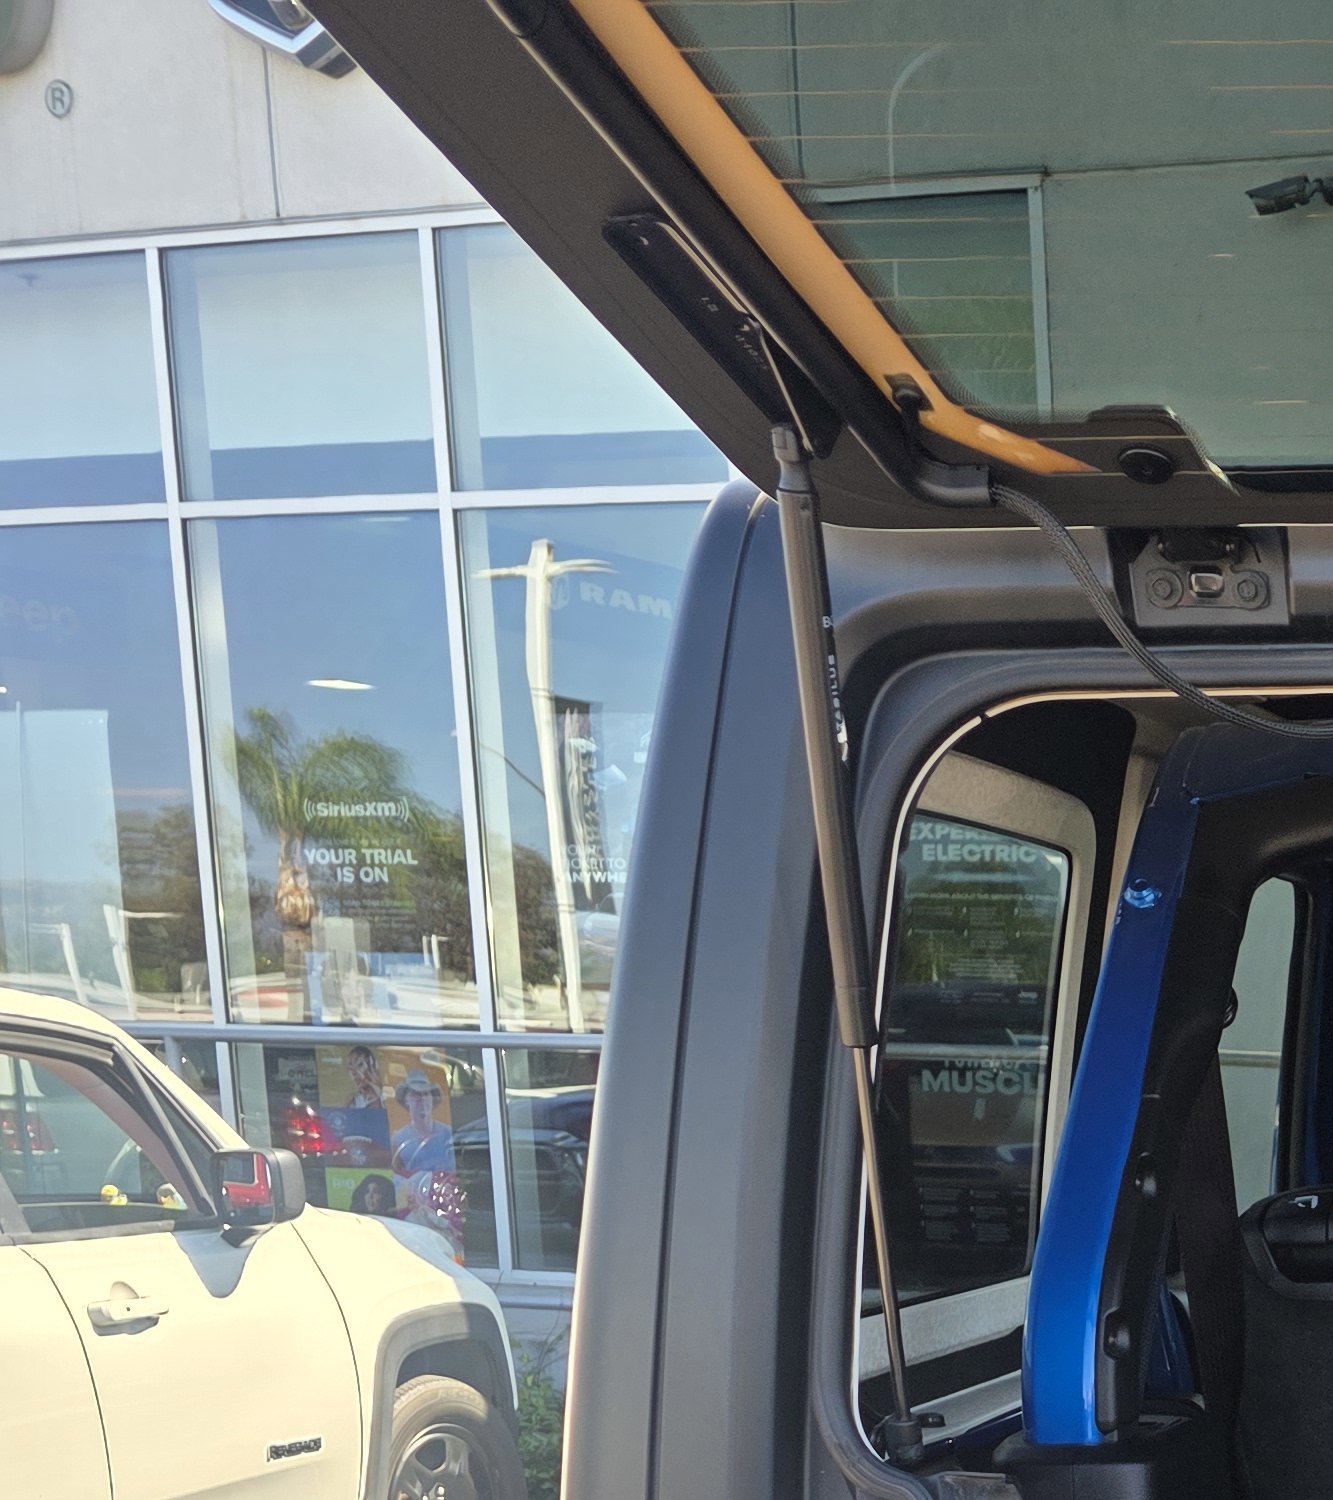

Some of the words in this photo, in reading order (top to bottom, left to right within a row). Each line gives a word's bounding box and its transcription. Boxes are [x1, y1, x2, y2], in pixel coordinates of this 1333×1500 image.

[579, 580, 674, 621] RAM
[303, 848, 357, 865] YOUR
[361, 848, 419, 865] TRIAL
[922, 843, 1037, 863] ELECTRIC
[336, 866, 355, 883] IS
[359, 866, 389, 883] ON
